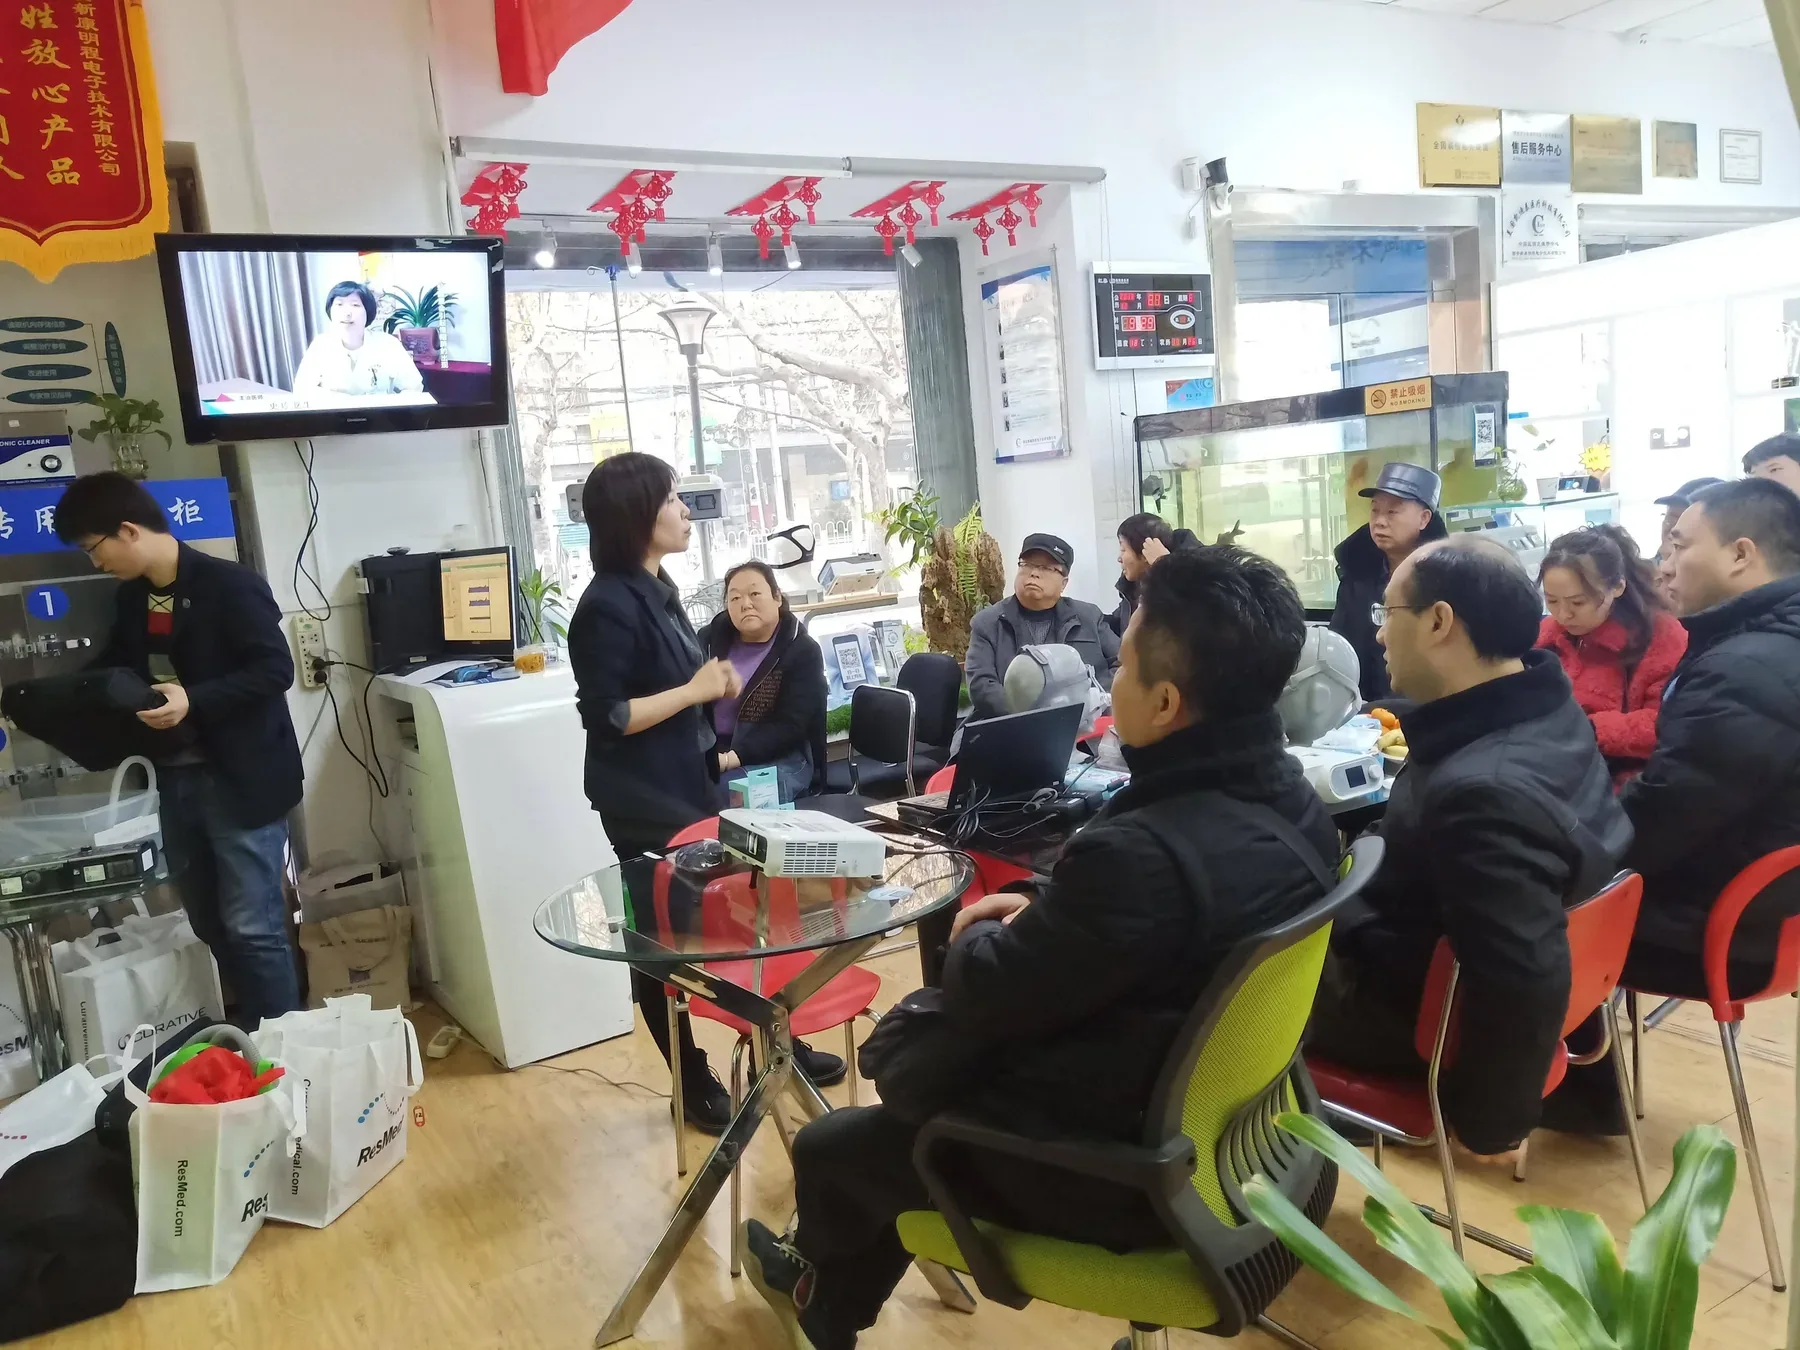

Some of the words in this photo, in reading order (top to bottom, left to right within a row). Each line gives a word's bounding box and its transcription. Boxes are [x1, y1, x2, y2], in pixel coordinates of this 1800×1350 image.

[20, 2, 81, 186] 姓放心产品
[1511, 140, 1563, 157] 售后服务中心
[1389, 384, 1426, 399] 禁止吸烟
[1400, 397, 1426, 406] SMOKING
[17, 438, 50, 446] CLEANER
[39, 591, 54, 616] 1
[133, 1006, 207, 1043] CURATIVE
[357, 1115, 404, 1168] ResMed
[174, 1159, 189, 1237] ResMed.com
